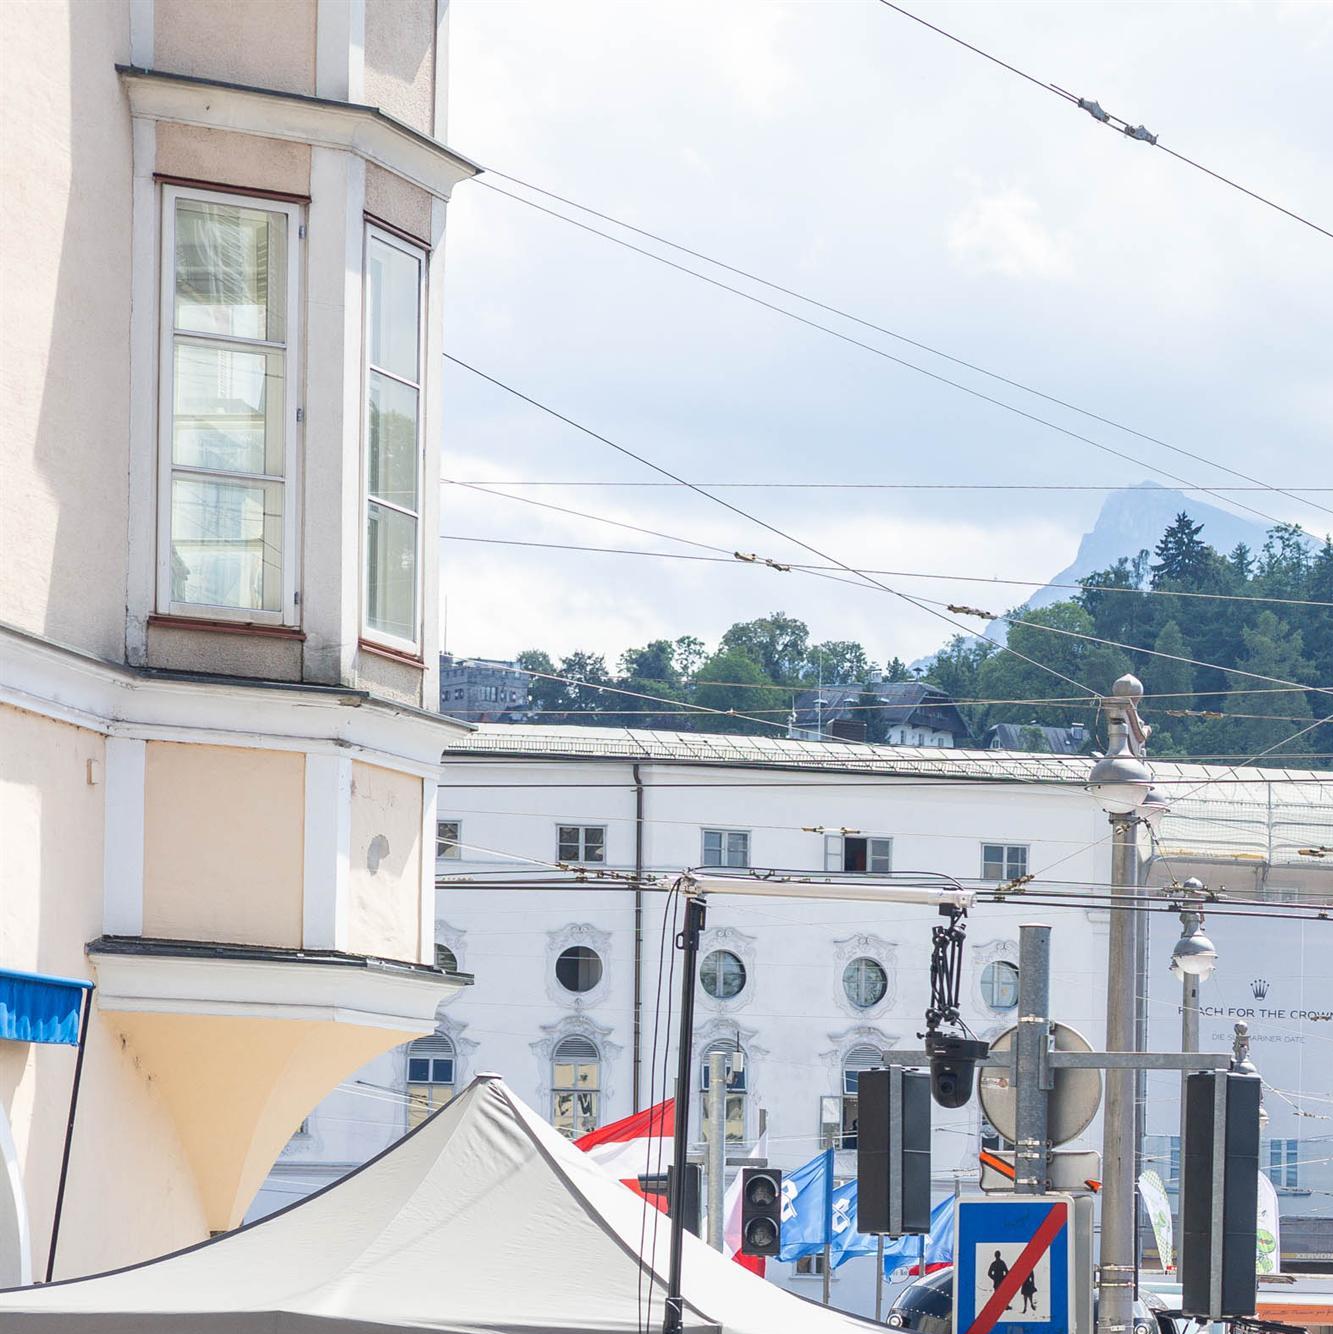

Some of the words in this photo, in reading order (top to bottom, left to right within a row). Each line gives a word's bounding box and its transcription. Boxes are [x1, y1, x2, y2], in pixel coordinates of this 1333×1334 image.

[1228, 1008, 1256, 1018] FOR
[1259, 1009, 1286, 1019] THE
[1212, 1033, 1225, 1042] DIE
